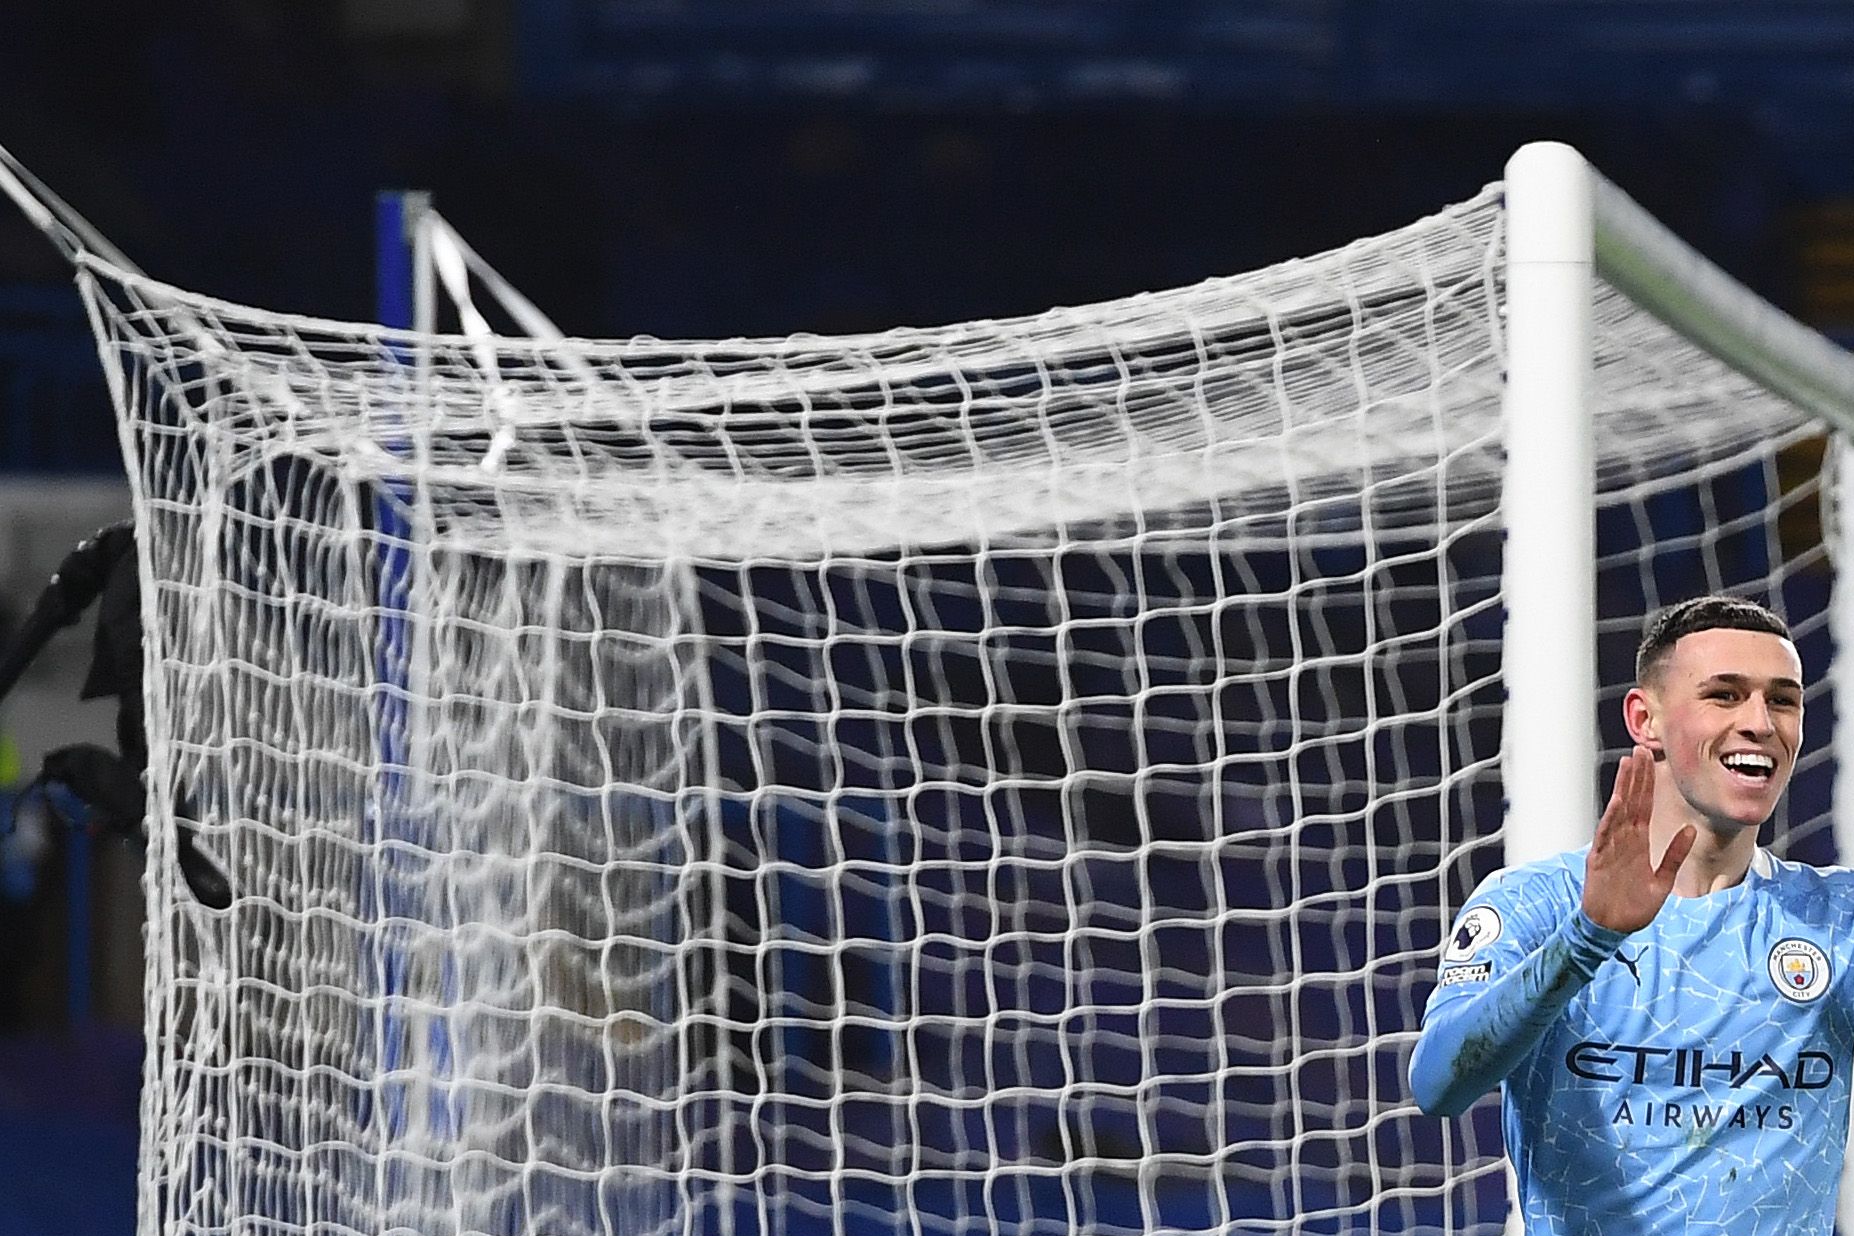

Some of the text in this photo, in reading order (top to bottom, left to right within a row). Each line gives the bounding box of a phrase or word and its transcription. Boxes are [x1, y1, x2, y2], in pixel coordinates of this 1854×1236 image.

[1772, 942, 1823, 962] MANCHESTER
[1792, 990, 1811, 998] CITY
[1565, 1040, 1834, 1090] ETIHAD
[1612, 1100, 1795, 1130] AIRWAYS
